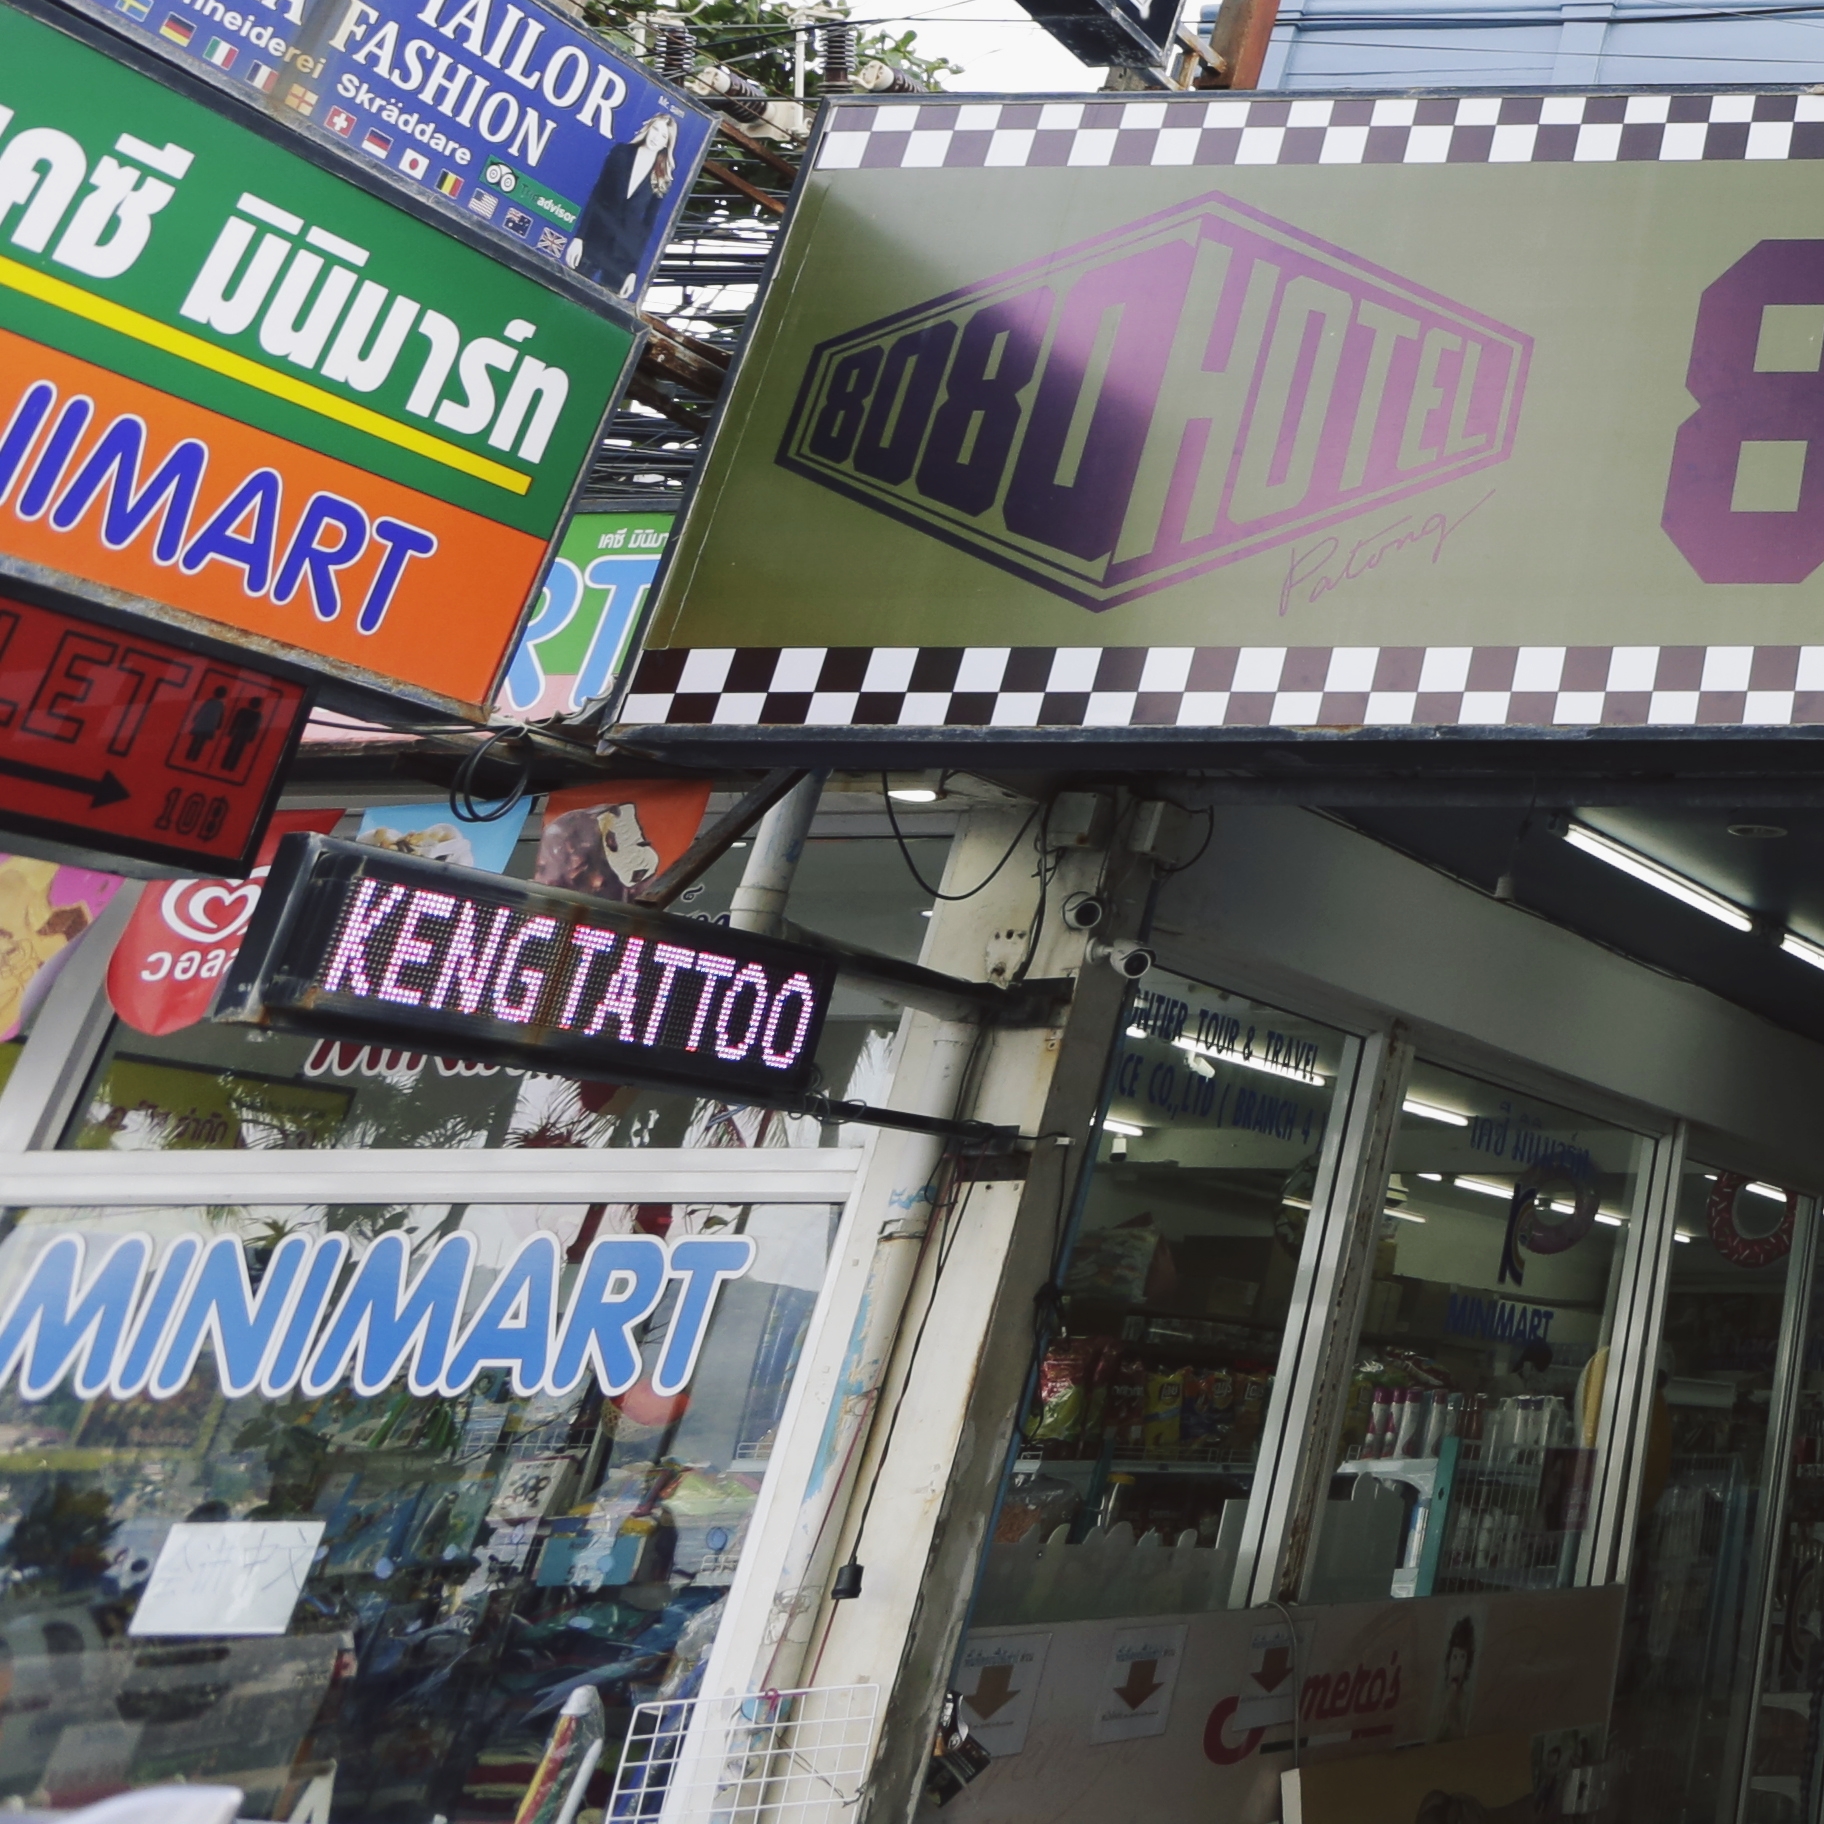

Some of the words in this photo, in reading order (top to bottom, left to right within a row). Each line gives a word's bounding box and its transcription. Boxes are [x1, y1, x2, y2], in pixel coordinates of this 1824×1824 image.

[336, 71, 472, 166] Skräddare
[0, 106, 195, 279] คซี
[178, 191, 571, 465] มินิมาร์ท
[808, 237, 1200, 563] 8080
[1110, 238, 1488, 567] HOTEL
[0, 379, 437, 635] IMART
[1278, 488, 1497, 617] Patong
[140, 946, 239, 982] วอล
[323, 877, 558, 1024] KENG
[558, 922, 815, 1069] TATTOO
[1195, 1008, 1240, 1058] TOUR
[1263, 1029, 1319, 1083] TRAVEL
[1231, 1087, 1298, 1141] BRANCH
[0, 1229, 757, 1401] MINIMART
[1446, 1292, 1554, 1345] MINIMART
